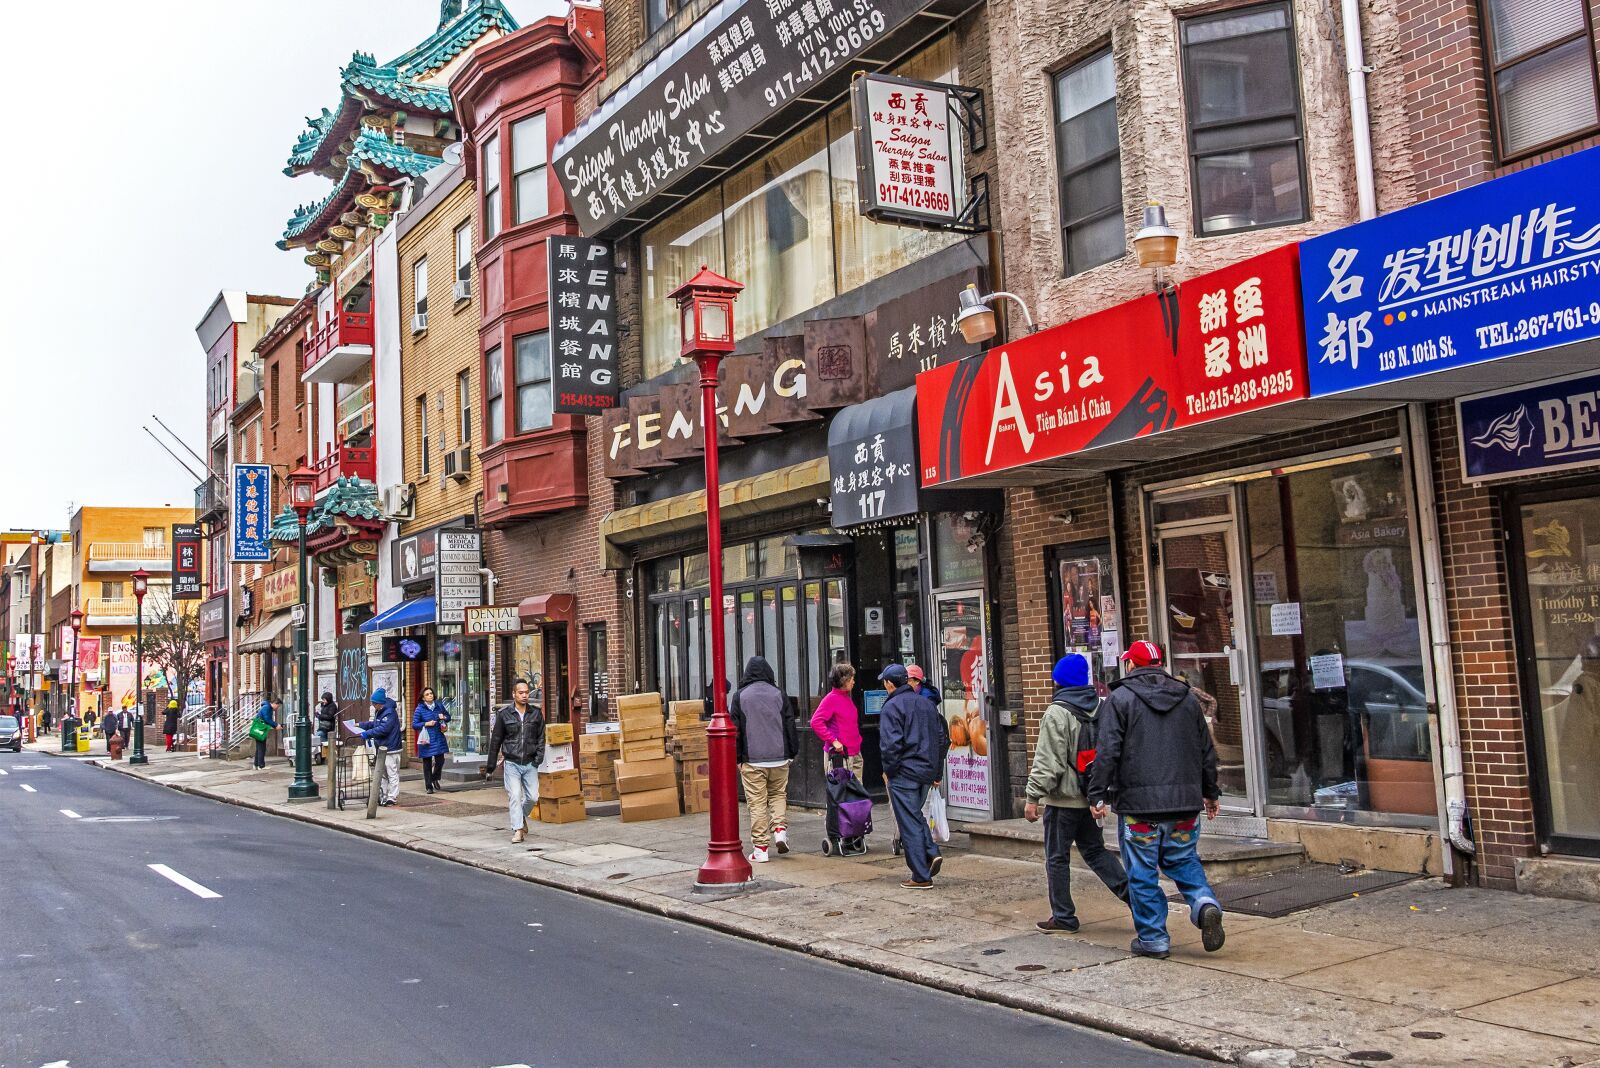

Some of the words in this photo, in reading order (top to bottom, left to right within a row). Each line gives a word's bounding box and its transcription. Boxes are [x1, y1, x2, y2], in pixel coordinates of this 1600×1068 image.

[706, 15, 756, 66] 蒸氣健身
[797, 37, 813, 58] 117
[813, 27, 830, 46] N.
[828, 8, 855, 35] 10th
[853, 0, 874, 17] St.
[717, 43, 767, 94] 美容瘦身
[764, 9, 886, 108] 917-412-9669
[873, 111, 946, 131] 健身理容中心
[888, 92, 929, 117] 西貢
[564, 144, 615, 198] Saigon
[609, 109, 667, 157] Therapy
[664, 72, 711, 121] Salon
[875, 140, 915, 160] Therapy
[917, 147, 948, 162] Salon
[889, 128, 932, 148] Saigon
[587, 110, 725, 221] 西貢健身理容中心
[880, 183, 949, 212] 917-412-9669
[1378, 202, 1577, 303] 发型创作
[558, 244, 583, 379] 馬來檳城餐館
[587, 244, 613, 386] PENANG
[1317, 247, 1374, 370] 名都
[1424, 279, 1526, 318] MAINSTREAM
[919, 353, 938, 373] 117
[1379, 352, 1397, 372] 113
[1399, 346, 1411, 364] N.
[1412, 338, 1437, 363] 10th
[1440, 335, 1457, 357] St.
[985, 351, 1104, 466] Asia
[1186, 369, 1294, 416] Tel:215-238-9295
[998, 422, 1016, 433] Bakery
[1057, 405, 1080, 427] Bánh
[1088, 394, 1112, 419] Châu
[1538, 391, 1600, 452] BE
[854, 433, 885, 465] 西貢
[833, 461, 911, 495] 健身理容中心
[925, 466, 937, 480] 115
[858, 489, 886, 519] 117
[1351, 528, 1371, 539] Asia
[1373, 526, 1406, 538] Bakery
[470, 607, 516, 620] DENTAL
[1536, 595, 1585, 612] Timothy
[472, 620, 513, 633] OFFICE
